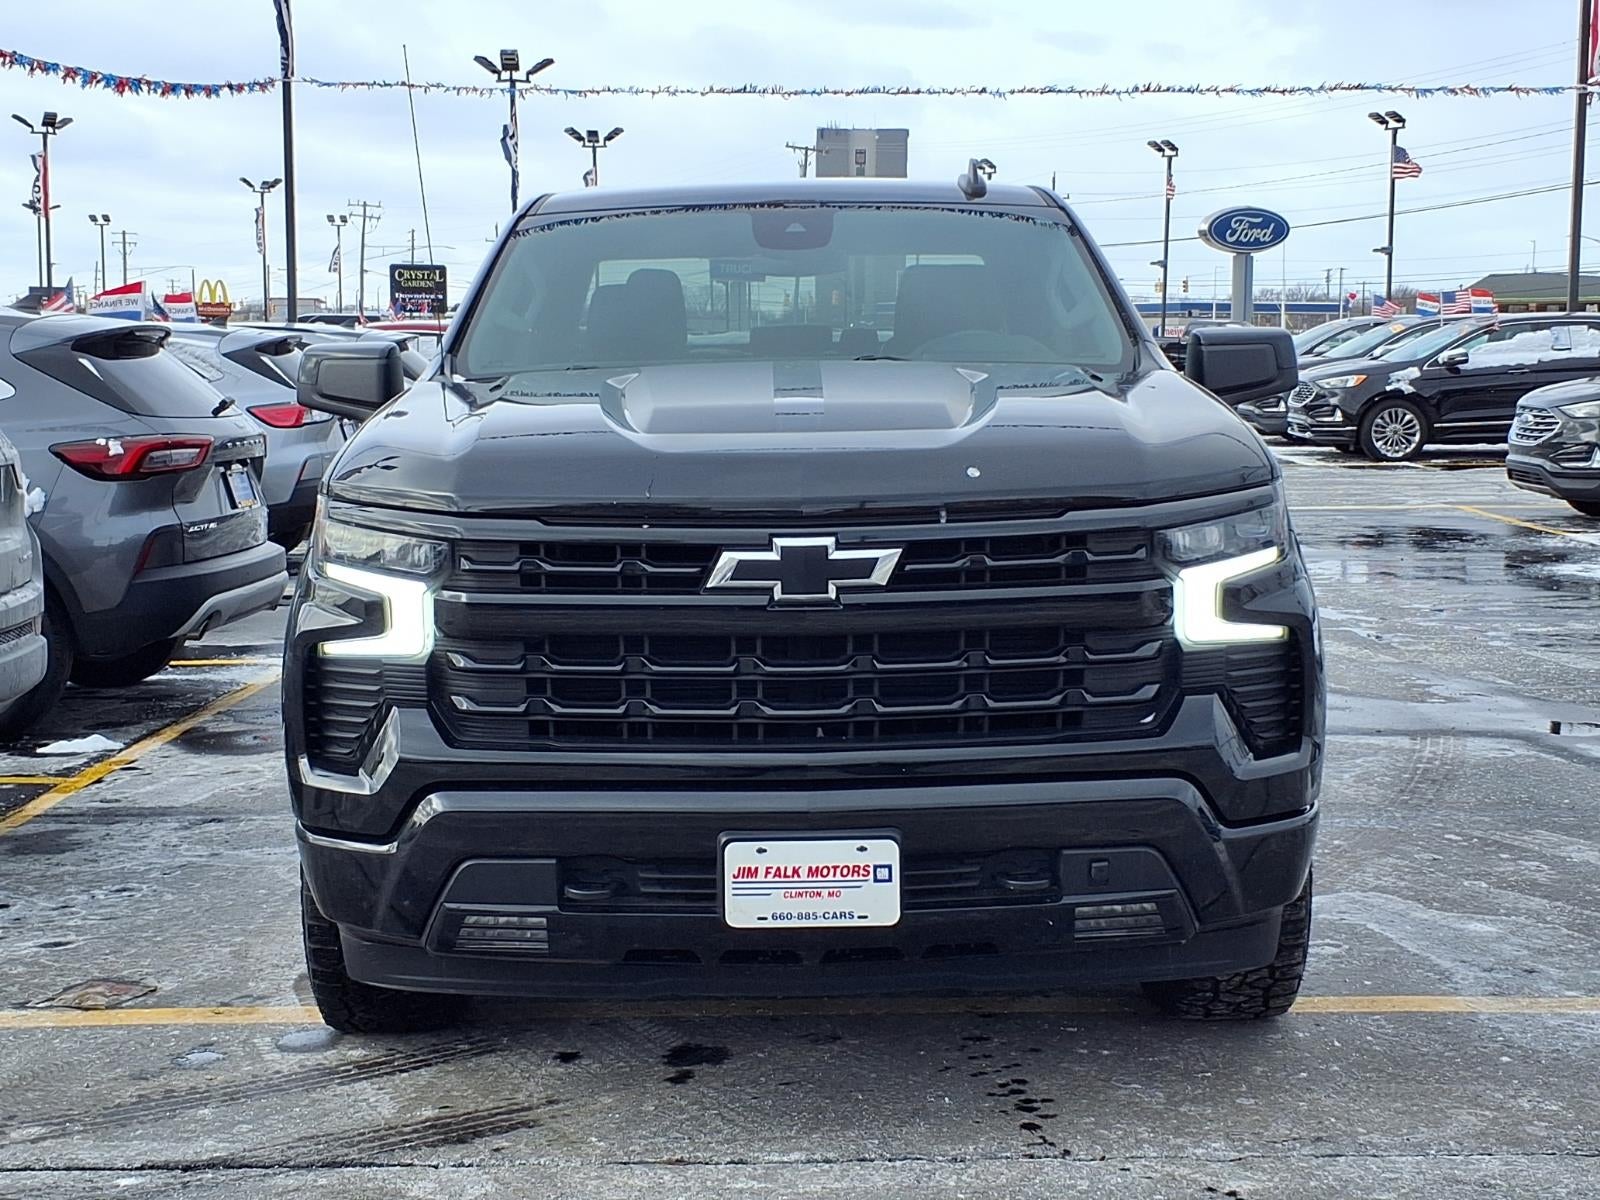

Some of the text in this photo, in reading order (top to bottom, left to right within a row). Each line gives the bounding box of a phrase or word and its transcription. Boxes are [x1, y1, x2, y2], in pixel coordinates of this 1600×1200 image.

[1225, 215, 1275, 243] Ford
[395, 269, 444, 281] CRYSTAL
[732, 864, 871, 880] JIM FALK MOTORS
[783, 890, 842, 900] CLINTON, MO
[771, 910, 855, 922] 660-885-CARS
